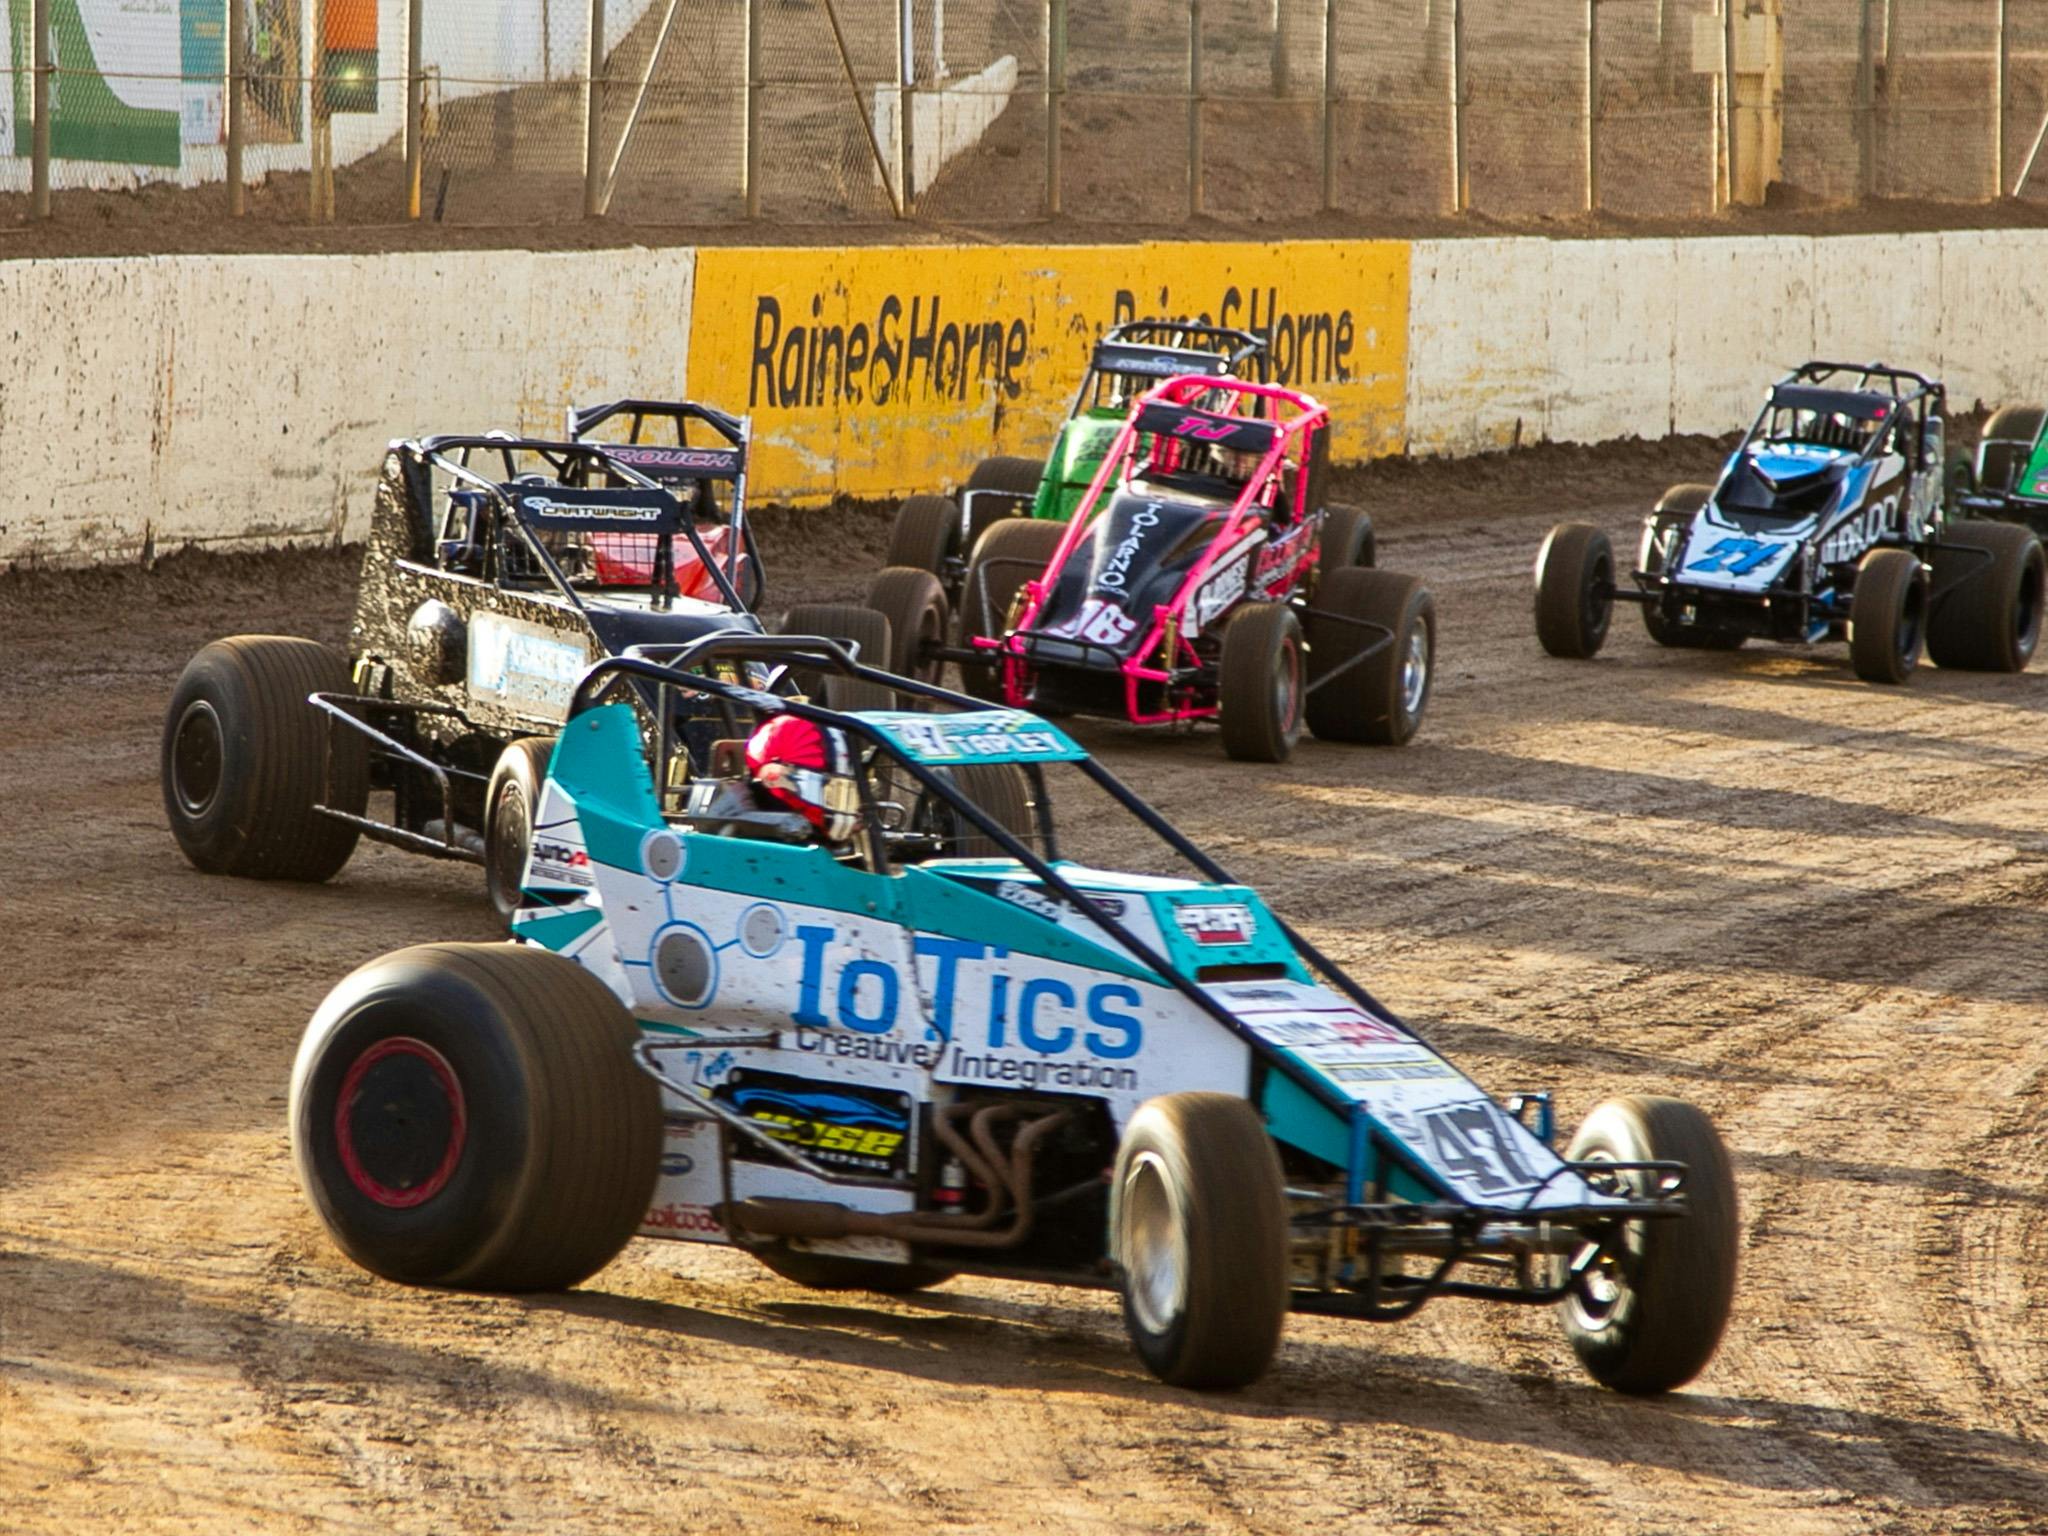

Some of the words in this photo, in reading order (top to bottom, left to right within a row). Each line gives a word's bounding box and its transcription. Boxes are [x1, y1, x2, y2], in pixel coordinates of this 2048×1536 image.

[748, 293, 1028, 409] Raine&Horne
[602, 447, 734, 468] ROUCH
[1173, 415, 1242, 441] TJ
[540, 503, 662, 521] CARTWRIGHT
[790, 924, 1143, 1060] IoTics
[797, 1031, 931, 1067] Creative
[952, 1046, 1138, 1091] Integration
[1422, 1106, 1538, 1194] 47
